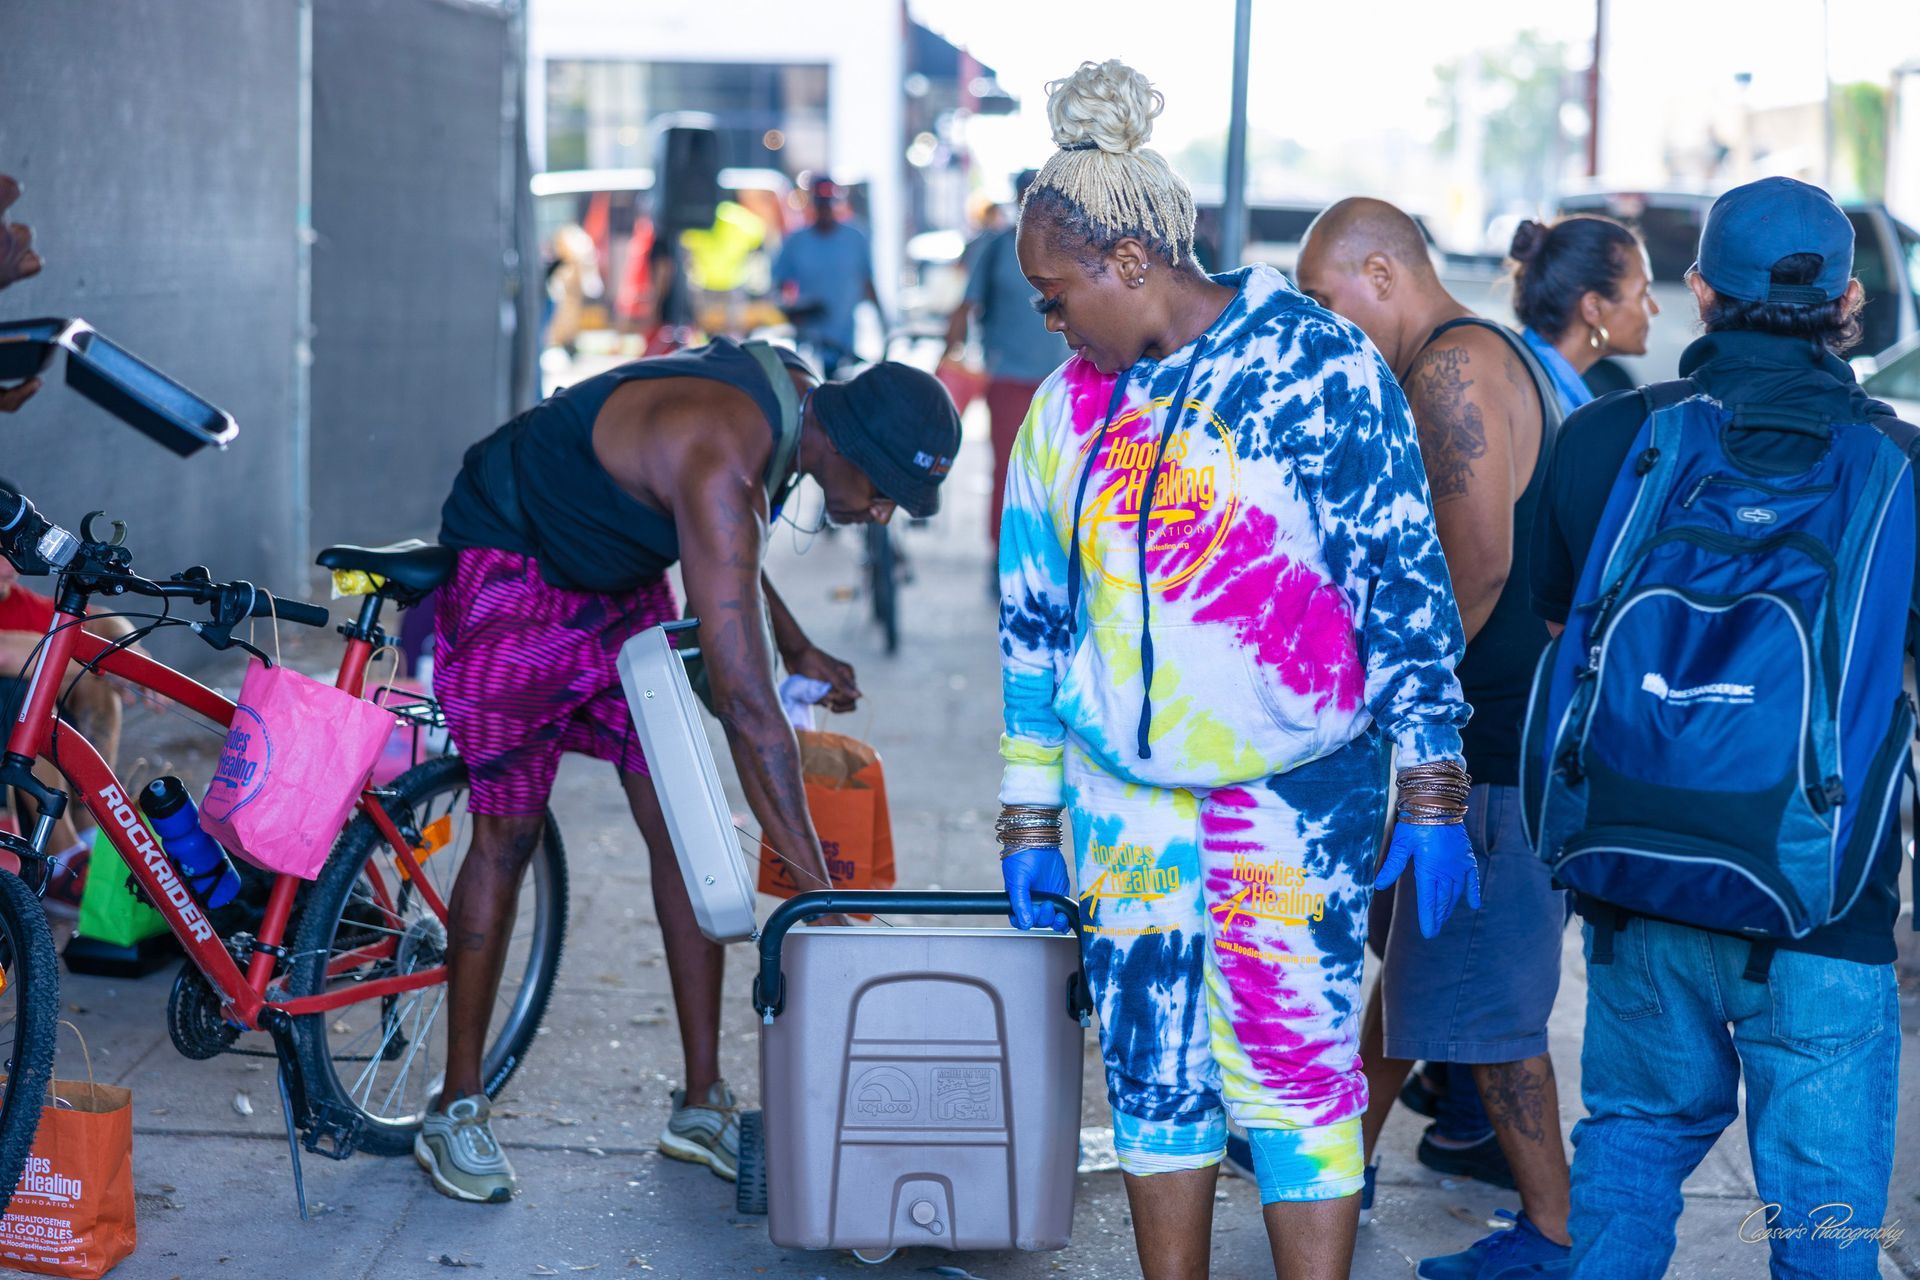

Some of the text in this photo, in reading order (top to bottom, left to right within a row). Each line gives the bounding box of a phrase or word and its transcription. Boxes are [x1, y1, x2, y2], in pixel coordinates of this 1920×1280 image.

[1125, 462, 1215, 511] Haling
[99, 784, 212, 943] ROCKRIDER
[1090, 839, 1155, 867] Hoodies
[1111, 864, 1180, 893] Healing
[1232, 854, 1307, 887] Hoodies
[1251, 882, 1325, 922] Healing
[937, 1102, 989, 1121] USA
[24, 1171, 82, 1200] Healing
